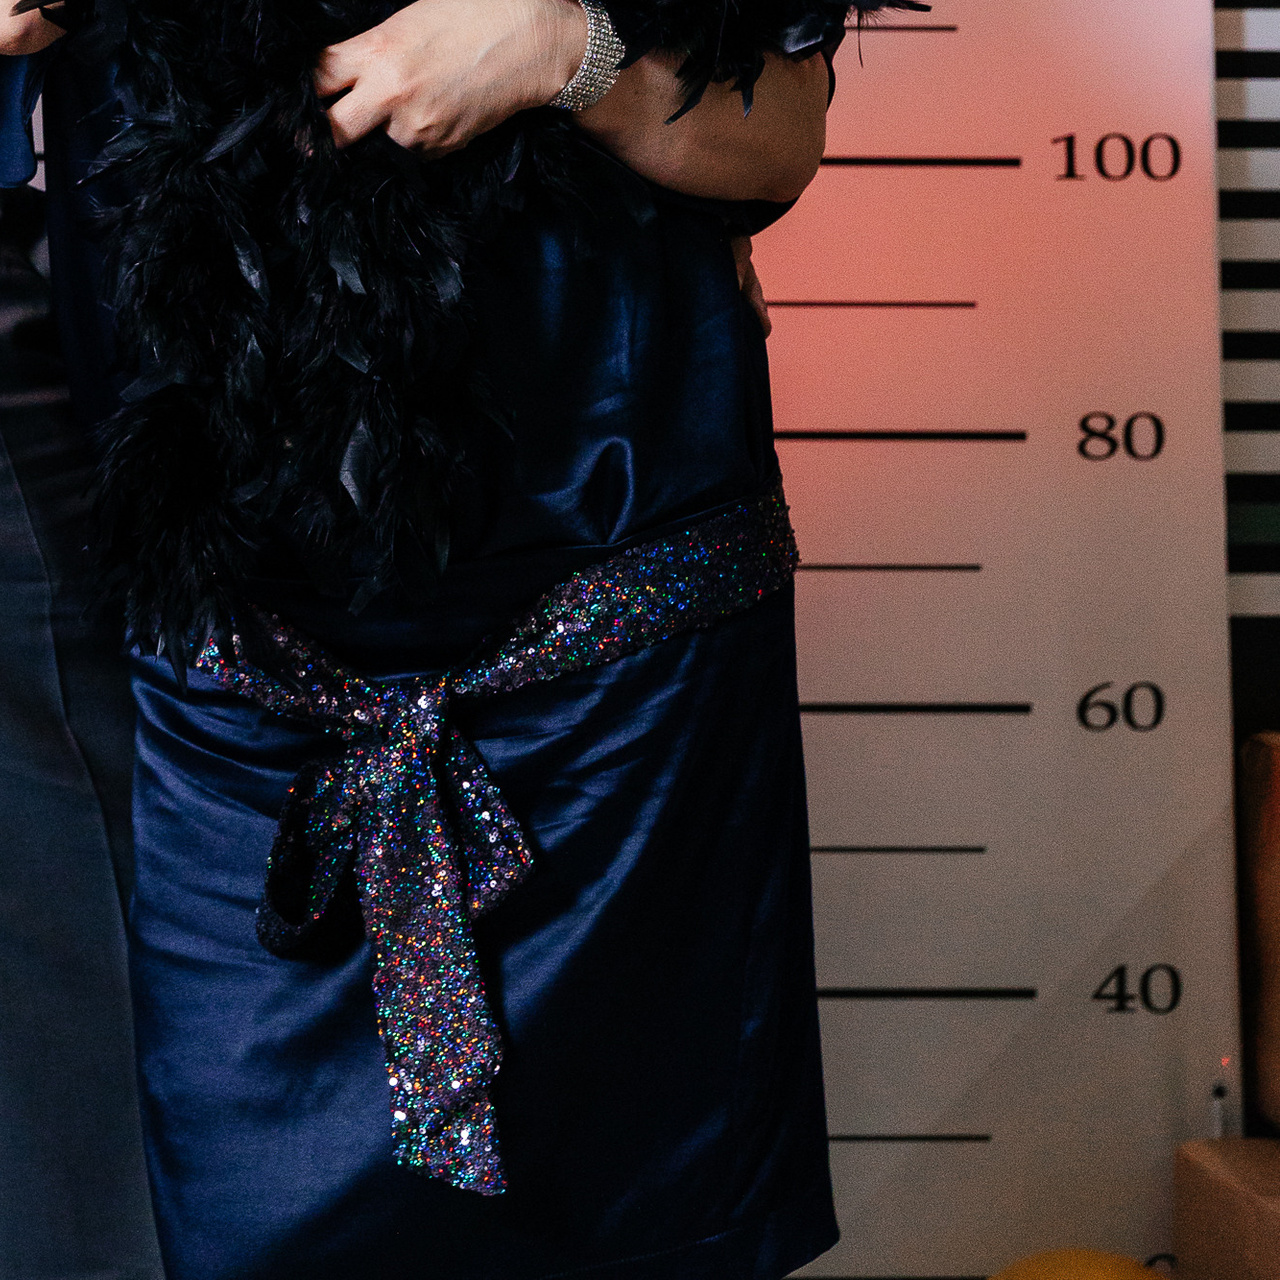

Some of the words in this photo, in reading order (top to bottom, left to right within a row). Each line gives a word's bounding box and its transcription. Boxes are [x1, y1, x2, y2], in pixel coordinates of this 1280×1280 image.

[1051, 132, 1182, 182] 100
[1076, 410, 1167, 462] 80
[1076, 680, 1166, 733] 60
[1091, 963, 1183, 1016] 40
